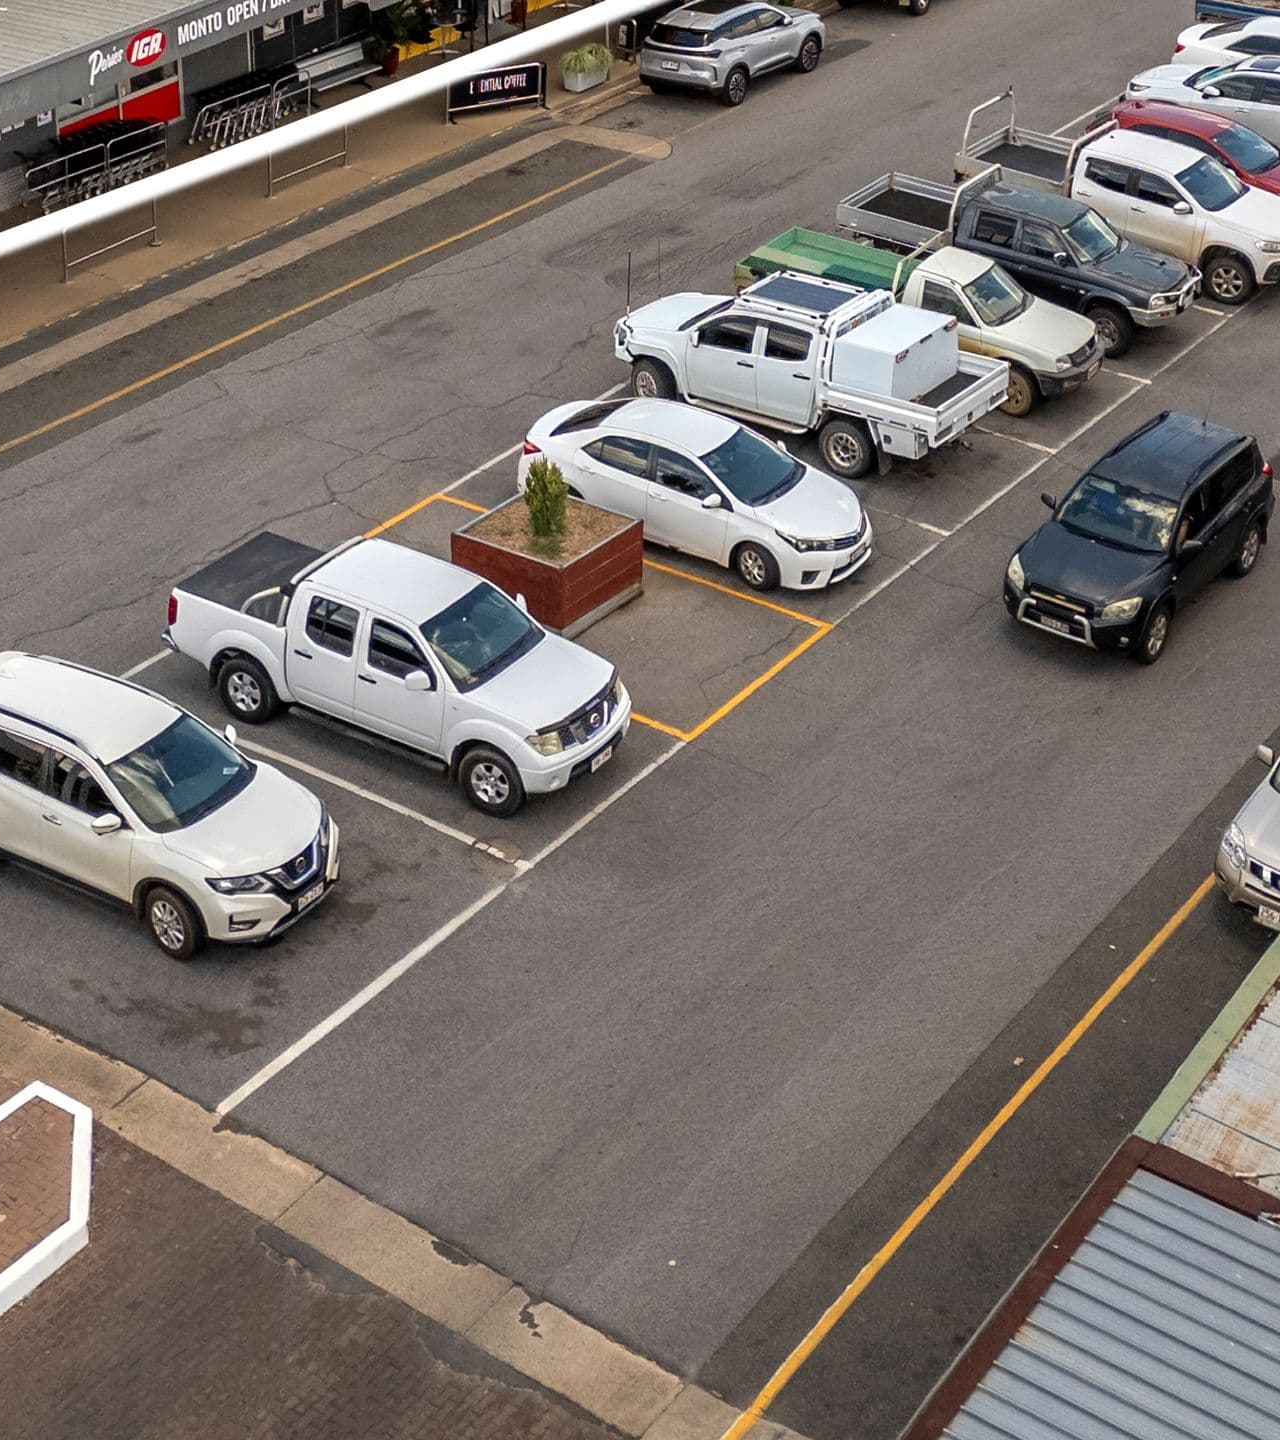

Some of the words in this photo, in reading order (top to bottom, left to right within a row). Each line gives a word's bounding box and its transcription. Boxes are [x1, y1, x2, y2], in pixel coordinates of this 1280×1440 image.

[177, 10, 222, 46] MONTO
[88, 45, 124, 86] Peries
[129, 31, 163, 63] IGA
